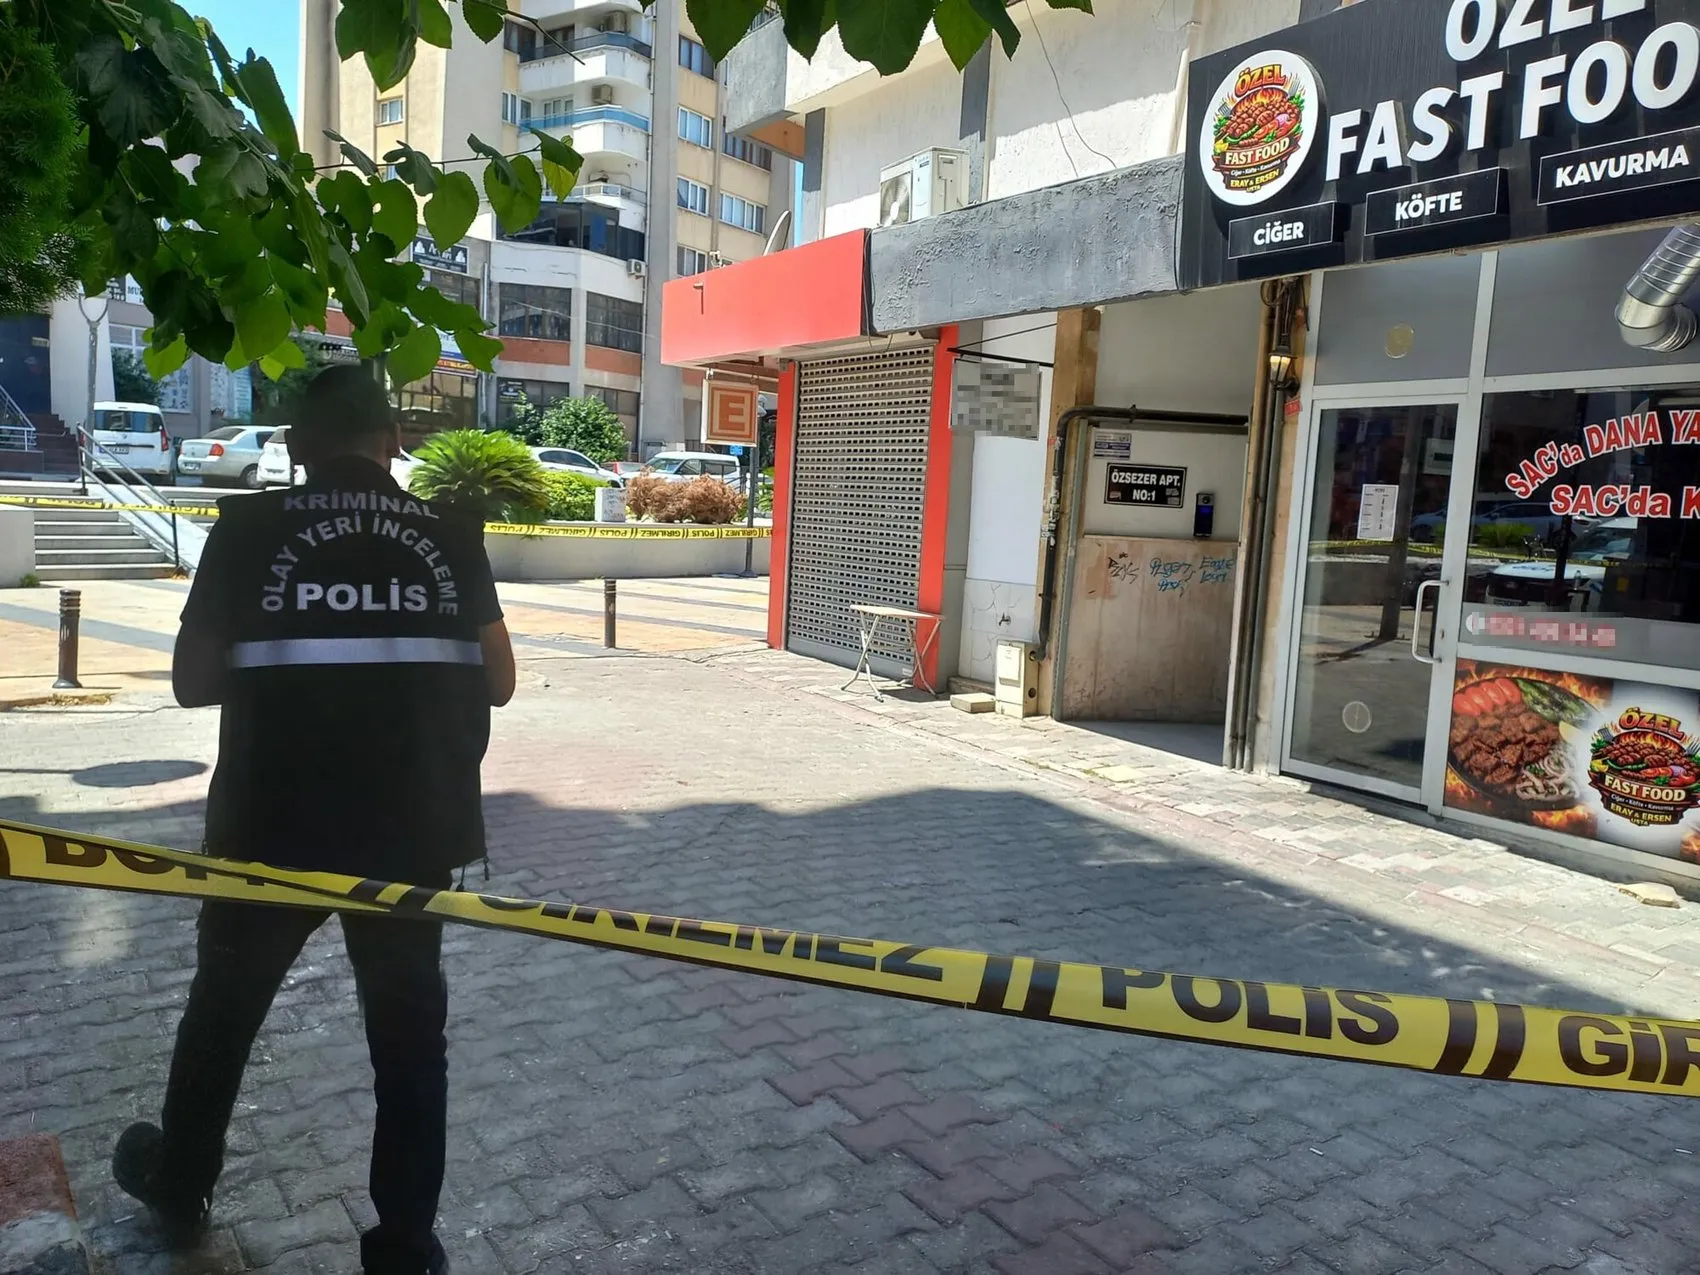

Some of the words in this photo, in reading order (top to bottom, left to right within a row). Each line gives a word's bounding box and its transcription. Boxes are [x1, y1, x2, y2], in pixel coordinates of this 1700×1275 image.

[1234, 64, 1286, 98] ÖZEL
[1326, 71, 1504, 182] FAST
[1225, 151, 1253, 165] FAST
[1255, 137, 1290, 162] FOOD
[1555, 145, 1690, 189] KAVURMA
[1395, 190, 1462, 223] KÖFTE
[1253, 220, 1304, 247] CİĞER
[1583, 410, 1664, 459] DANA
[1111, 468, 1158, 486] ÖZSEZER
[1159, 474, 1181, 487] APT.
[283, 488, 440, 520] KRİMİNAL
[1132, 488, 1156, 501] NO:1
[261, 545, 299, 612] OLAY
[296, 511, 362, 548] YERİ
[372, 512, 459, 616] İNCELEME
[296, 577, 428, 612] POLİS
[1618, 706, 1685, 740] ÖZEL
[1604, 774, 1640, 796] FAST
[1642, 786, 1686, 802] FOOD
[1610, 802, 1634, 817] ERAY
[1642, 812, 1672, 822] ERSEN
